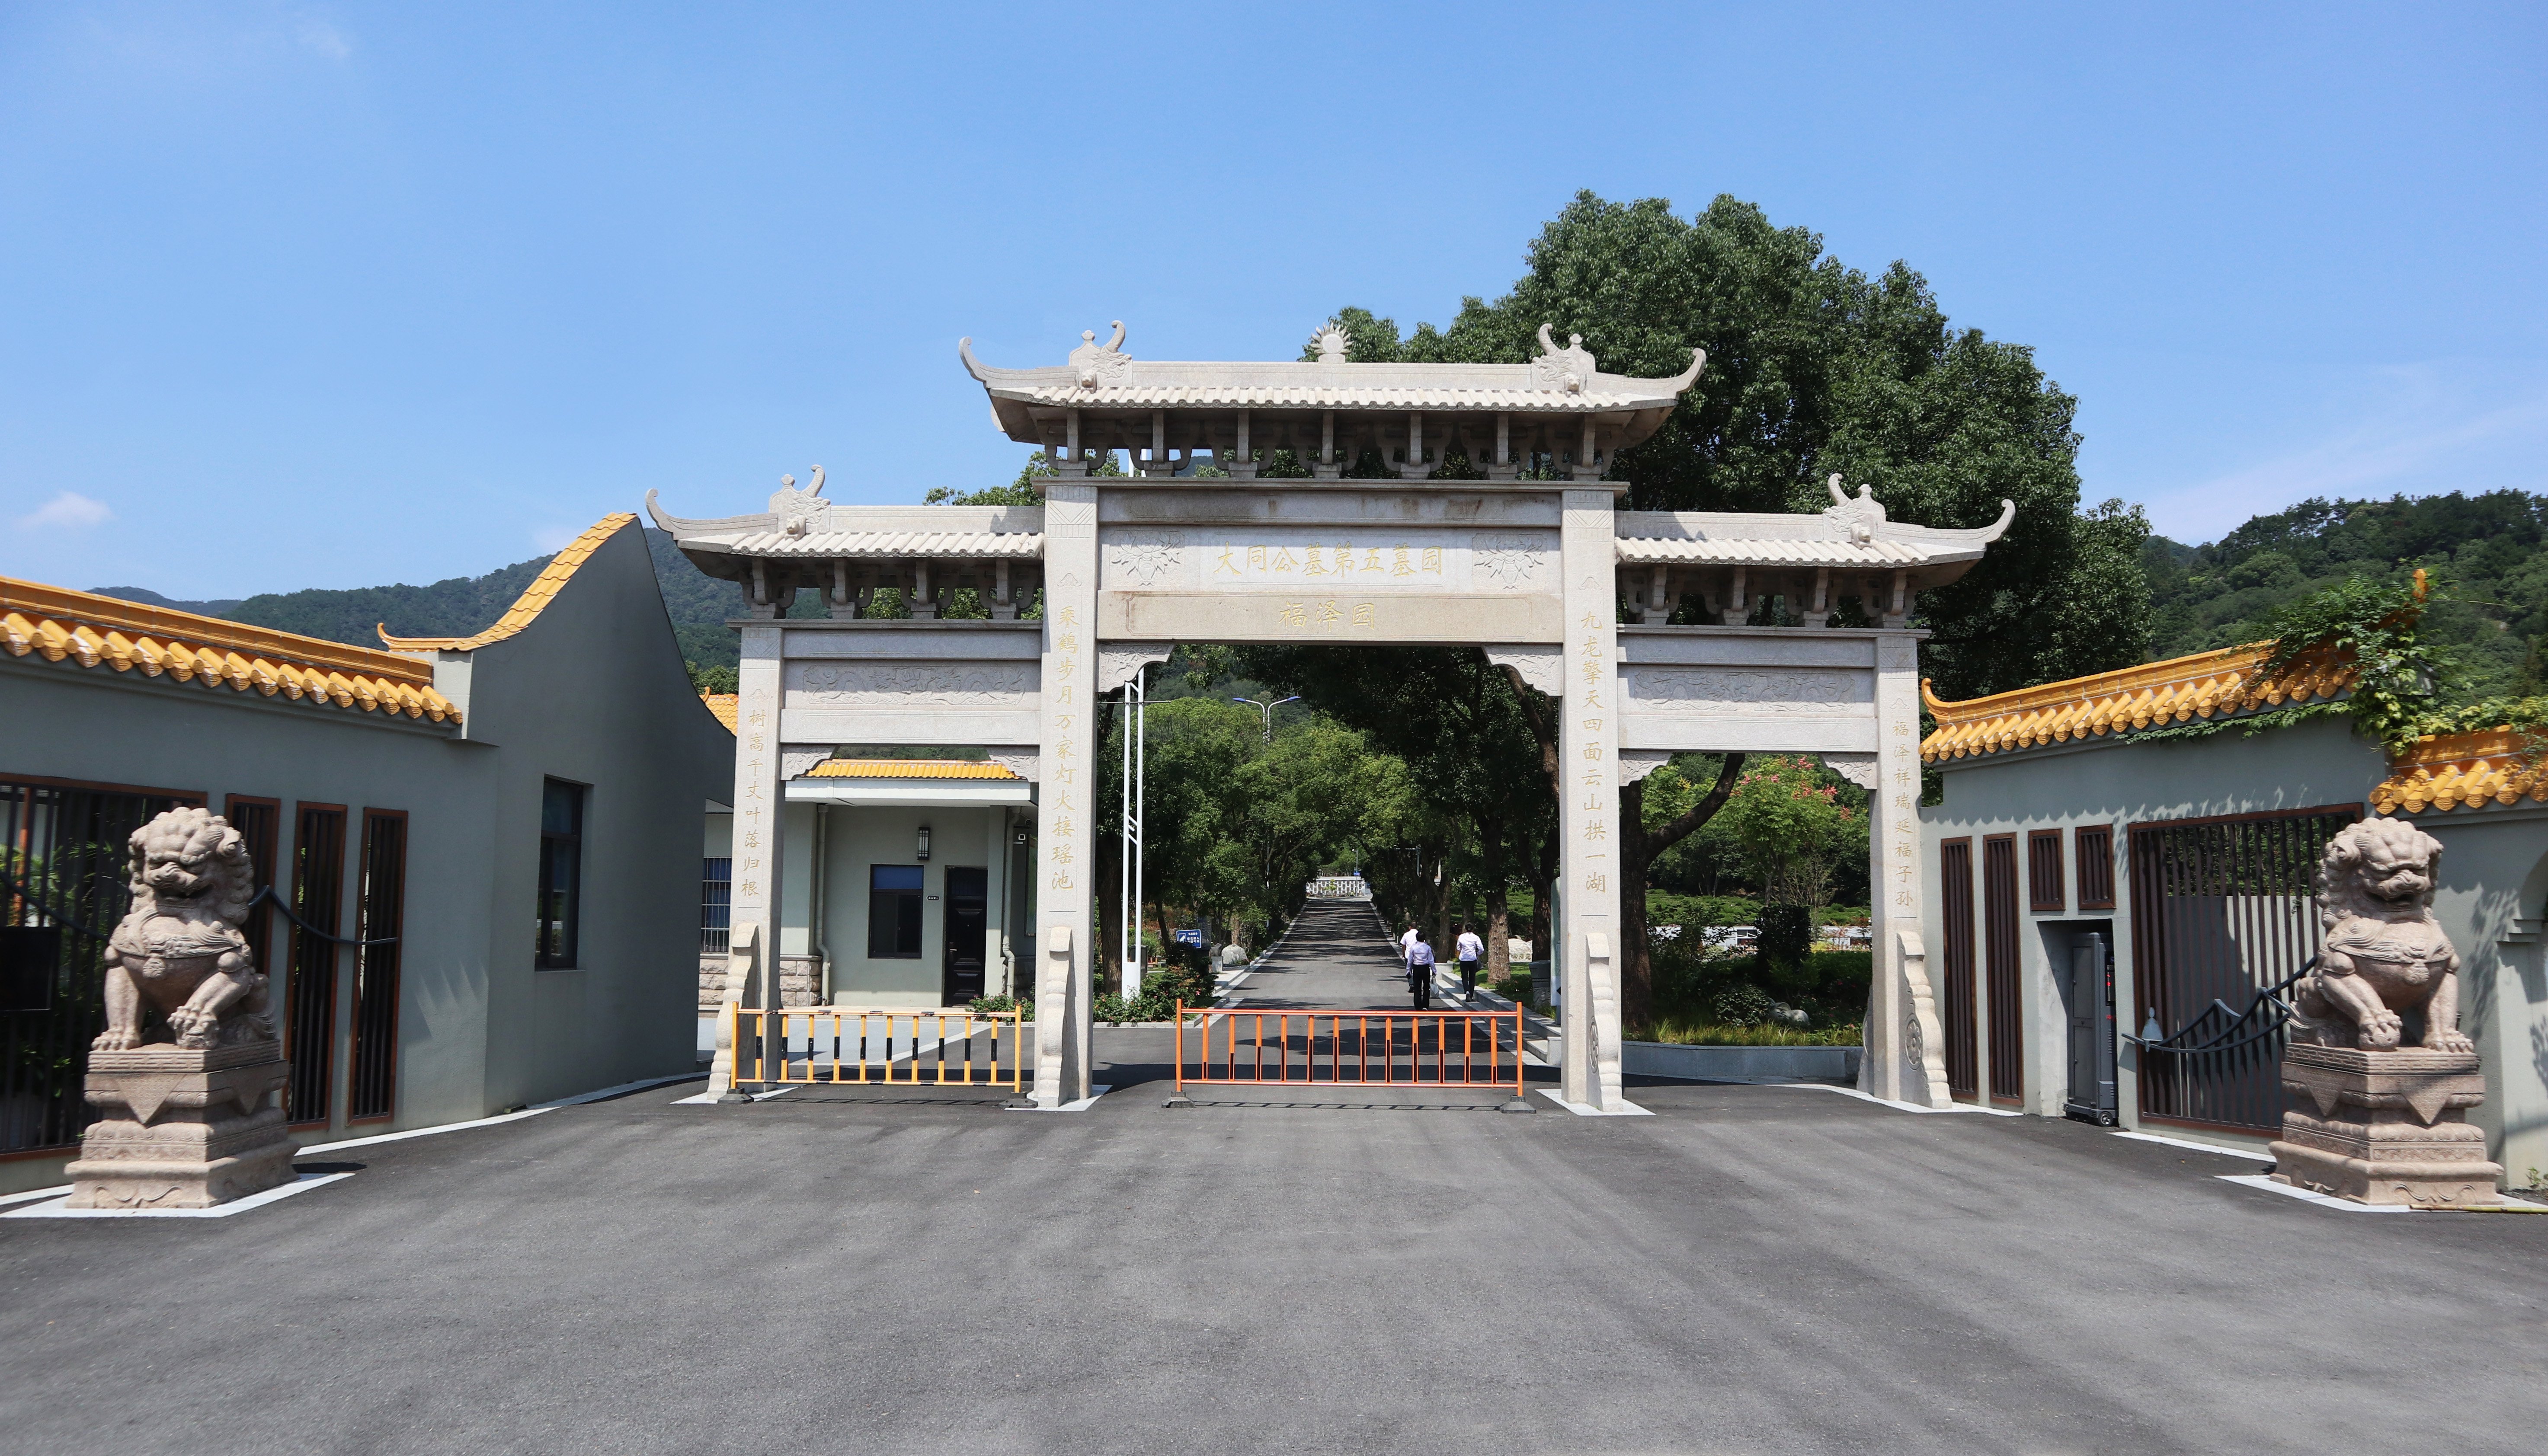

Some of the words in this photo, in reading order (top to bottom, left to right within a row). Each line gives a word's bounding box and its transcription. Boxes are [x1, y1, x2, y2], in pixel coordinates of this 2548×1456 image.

[1213, 541, 1442, 578] 大同公墓第五墓园
[1278, 600, 1374, 632] 福泽园
[740, 709, 766, 897] 树高千丈叶落归根
[1051, 605, 1080, 890] 乘鹤步月万家灯火接瑶池
[1581, 611, 1607, 893] 九龙擎天四面云山拱一湖
[1892, 720, 1914, 907] 福泽祥瑞延福子孙
